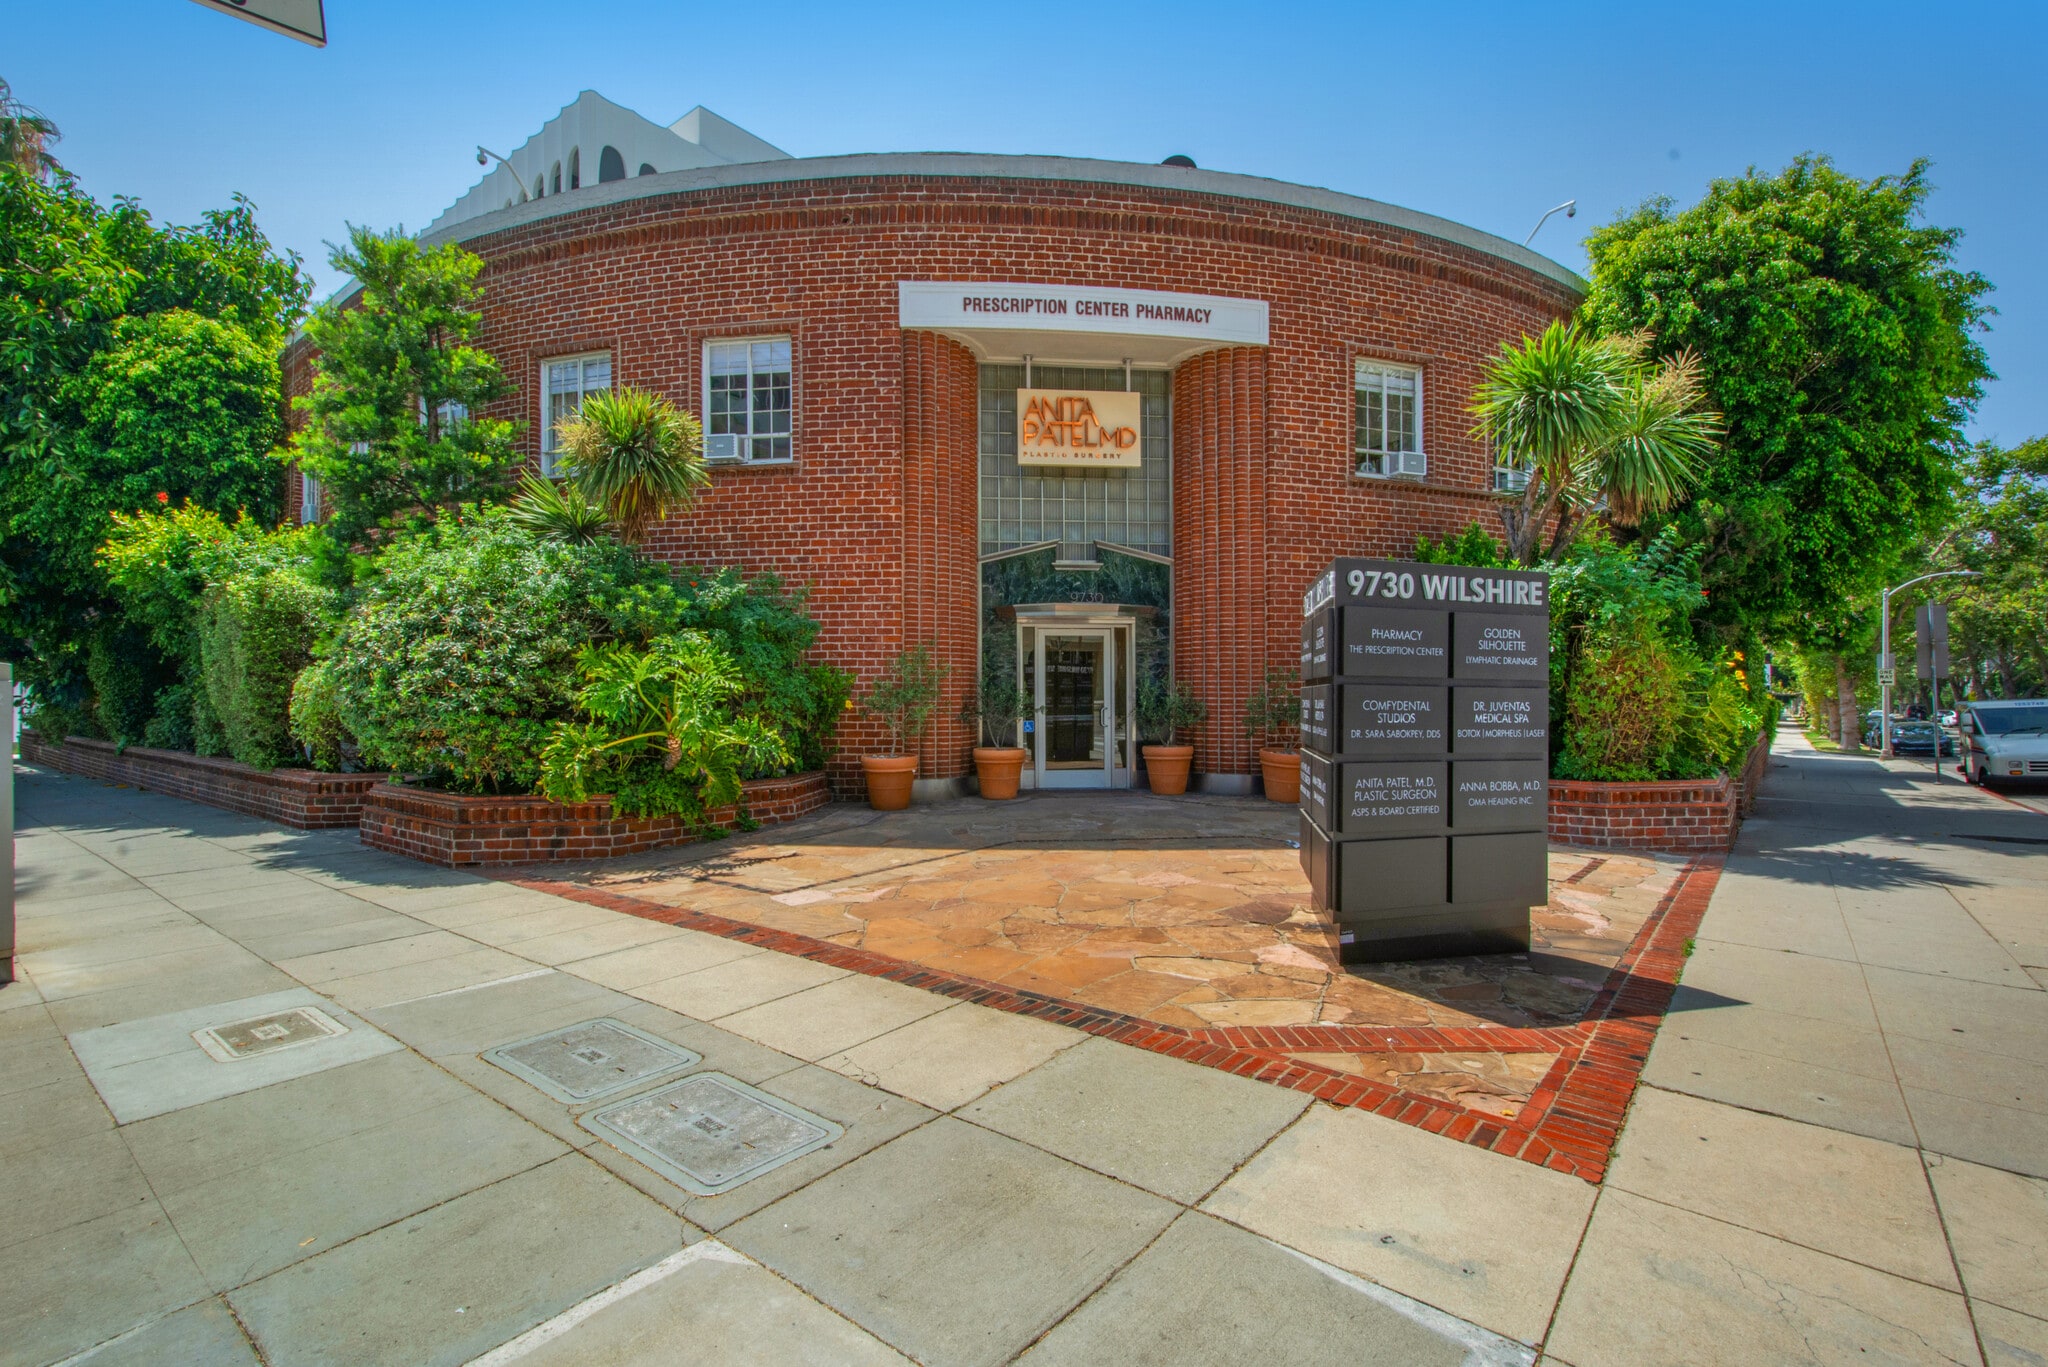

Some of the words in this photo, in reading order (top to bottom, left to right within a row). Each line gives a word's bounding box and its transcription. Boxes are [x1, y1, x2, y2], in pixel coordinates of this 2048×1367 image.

[963, 297, 1067, 314] PRESCRIPTION
[1075, 300, 1129, 318] CENTER
[1136, 303, 1212, 323] PHARMACY
[1023, 395, 1100, 427] ANITA
[1347, 569, 1414, 600] 9730
[1422, 574, 1543, 606] WILSHIRE
[1070, 591, 1104, 604] 9730
[1371, 628, 1423, 641] PHARMACY
[1484, 628, 1521, 639] GOLDEN
[1349, 645, 1363, 654] THE
[1365, 645, 1414, 656] PRESCRIPTION
[1416, 647, 1444, 656] CENTER
[1478, 639, 1526, 651] SILHOUETTE
[1465, 655, 1502, 665] LYMPHATIC
[1503, 656, 1538, 666] DRAINAGE
[1362, 699, 1431, 712] COMFYDENTAL
[1473, 701, 1487, 711] DR.
[1489, 701, 1531, 712] JUVENTAS
[1377, 712, 1416, 724] STUDIOS
[1474, 713, 1512, 724] MEDICAL
[1514, 713, 1530, 724] SPA
[1365, 729, 1385, 739] SARA
[1426, 729, 1441, 739] DDS
[1456, 729, 1481, 738] BOTOX
[1355, 777, 1384, 789] ANITA
[1459, 781, 1488, 792] ANNA
[1354, 789, 1389, 801] PLASTIC
[1391, 788, 1437, 801] SURGEON
[1468, 797, 1486, 806] OMA
[1487, 796, 1518, 806] HEALING
[1351, 807, 1370, 817] ASPS
[1371, 806, 1377, 816] &
[1378, 806, 1405, 816] BOARD
[1406, 805, 1440, 815] CERTIFIED
